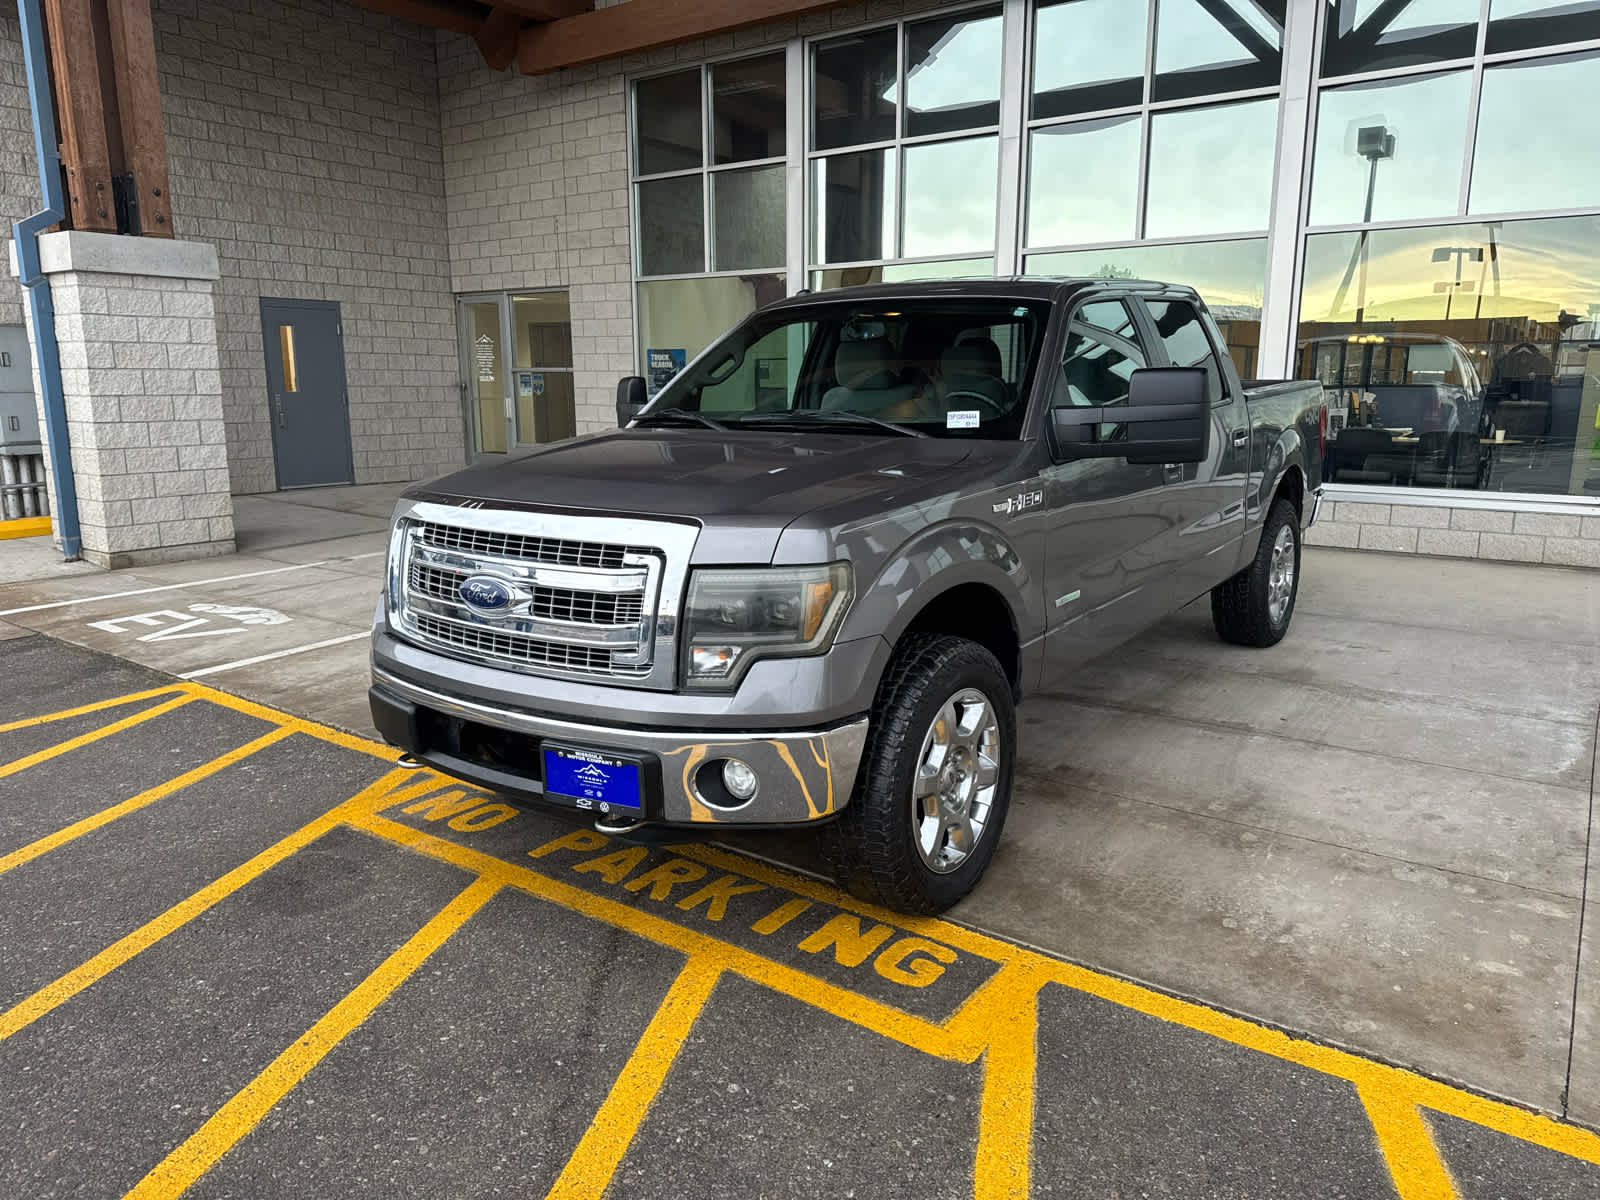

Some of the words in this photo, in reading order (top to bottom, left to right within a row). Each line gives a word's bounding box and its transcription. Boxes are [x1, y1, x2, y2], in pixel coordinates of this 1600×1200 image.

[651, 353, 670, 361] TRUCK
[470, 582, 501, 603] Ford
[86, 610, 249, 642] EV
[401, 790, 520, 832] NO
[528, 829, 958, 988] PARKING
